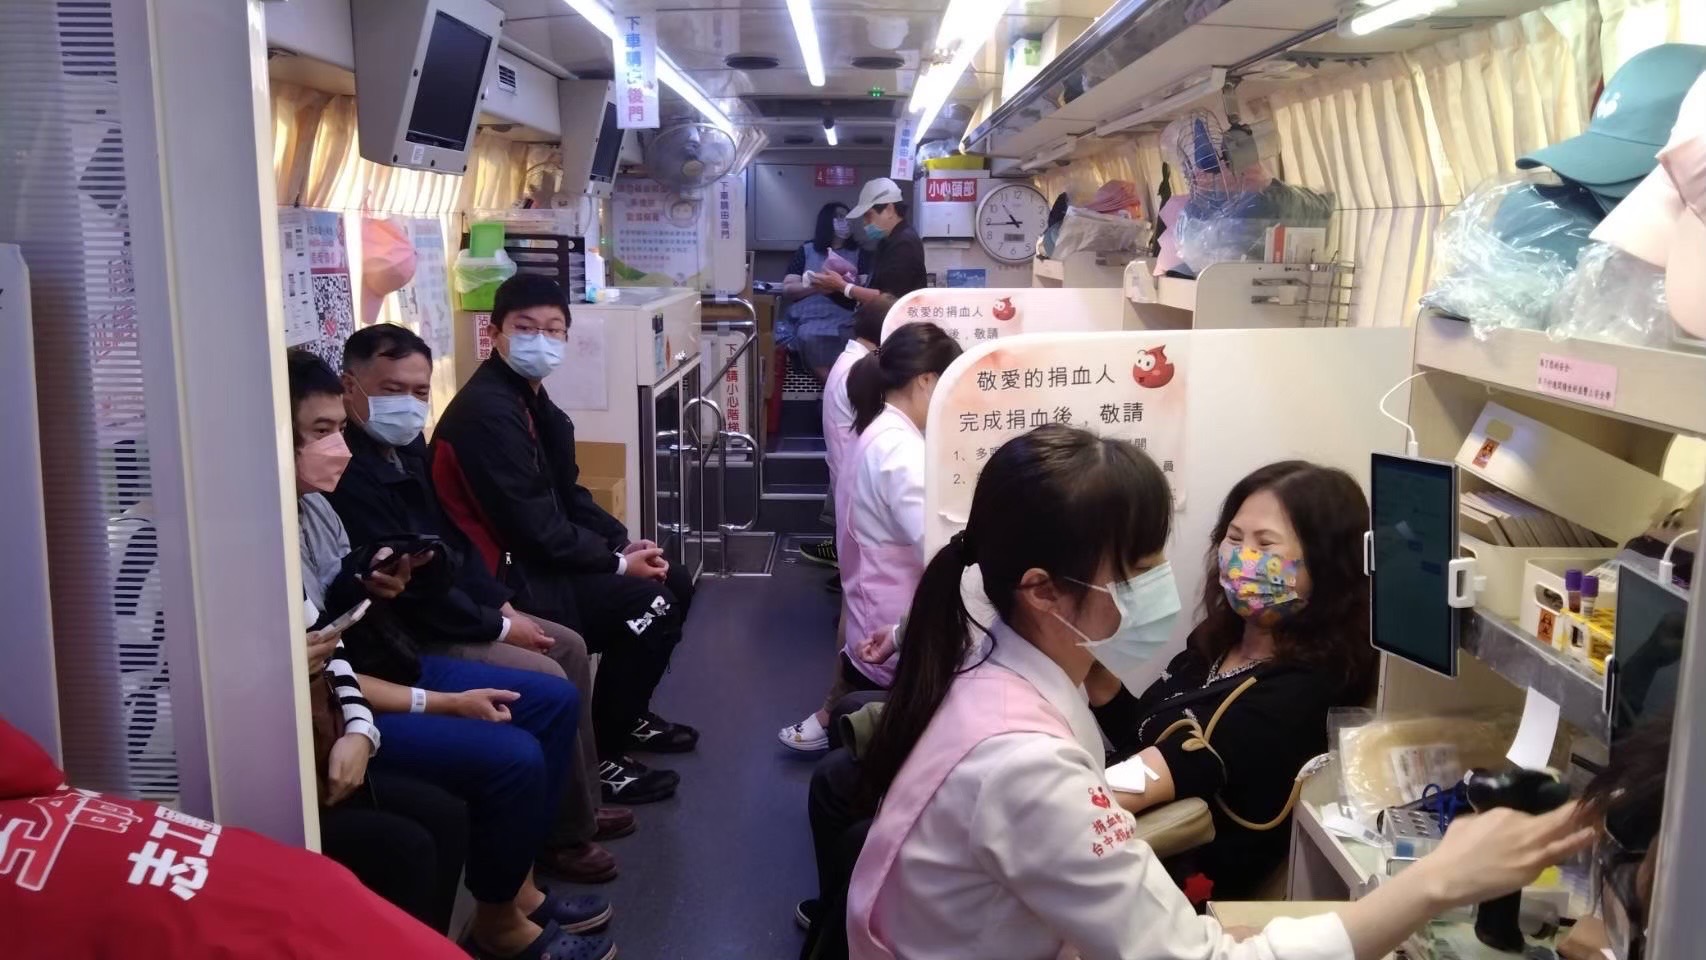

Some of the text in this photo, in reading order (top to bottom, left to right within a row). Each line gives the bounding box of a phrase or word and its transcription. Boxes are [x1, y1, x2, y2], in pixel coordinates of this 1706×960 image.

[929, 181, 975, 197] 小心頭部
[907, 305, 984, 318] 敬愛的捐血人
[479, 315, 491, 358] 沾血棉球
[944, 327, 999, 340] 後，敬請
[725, 343, 740, 432] 下車請小心階梯
[976, 364, 1116, 392] 敬愛的捐血人
[959, 402, 1144, 432] 完成捐血後，敬請
